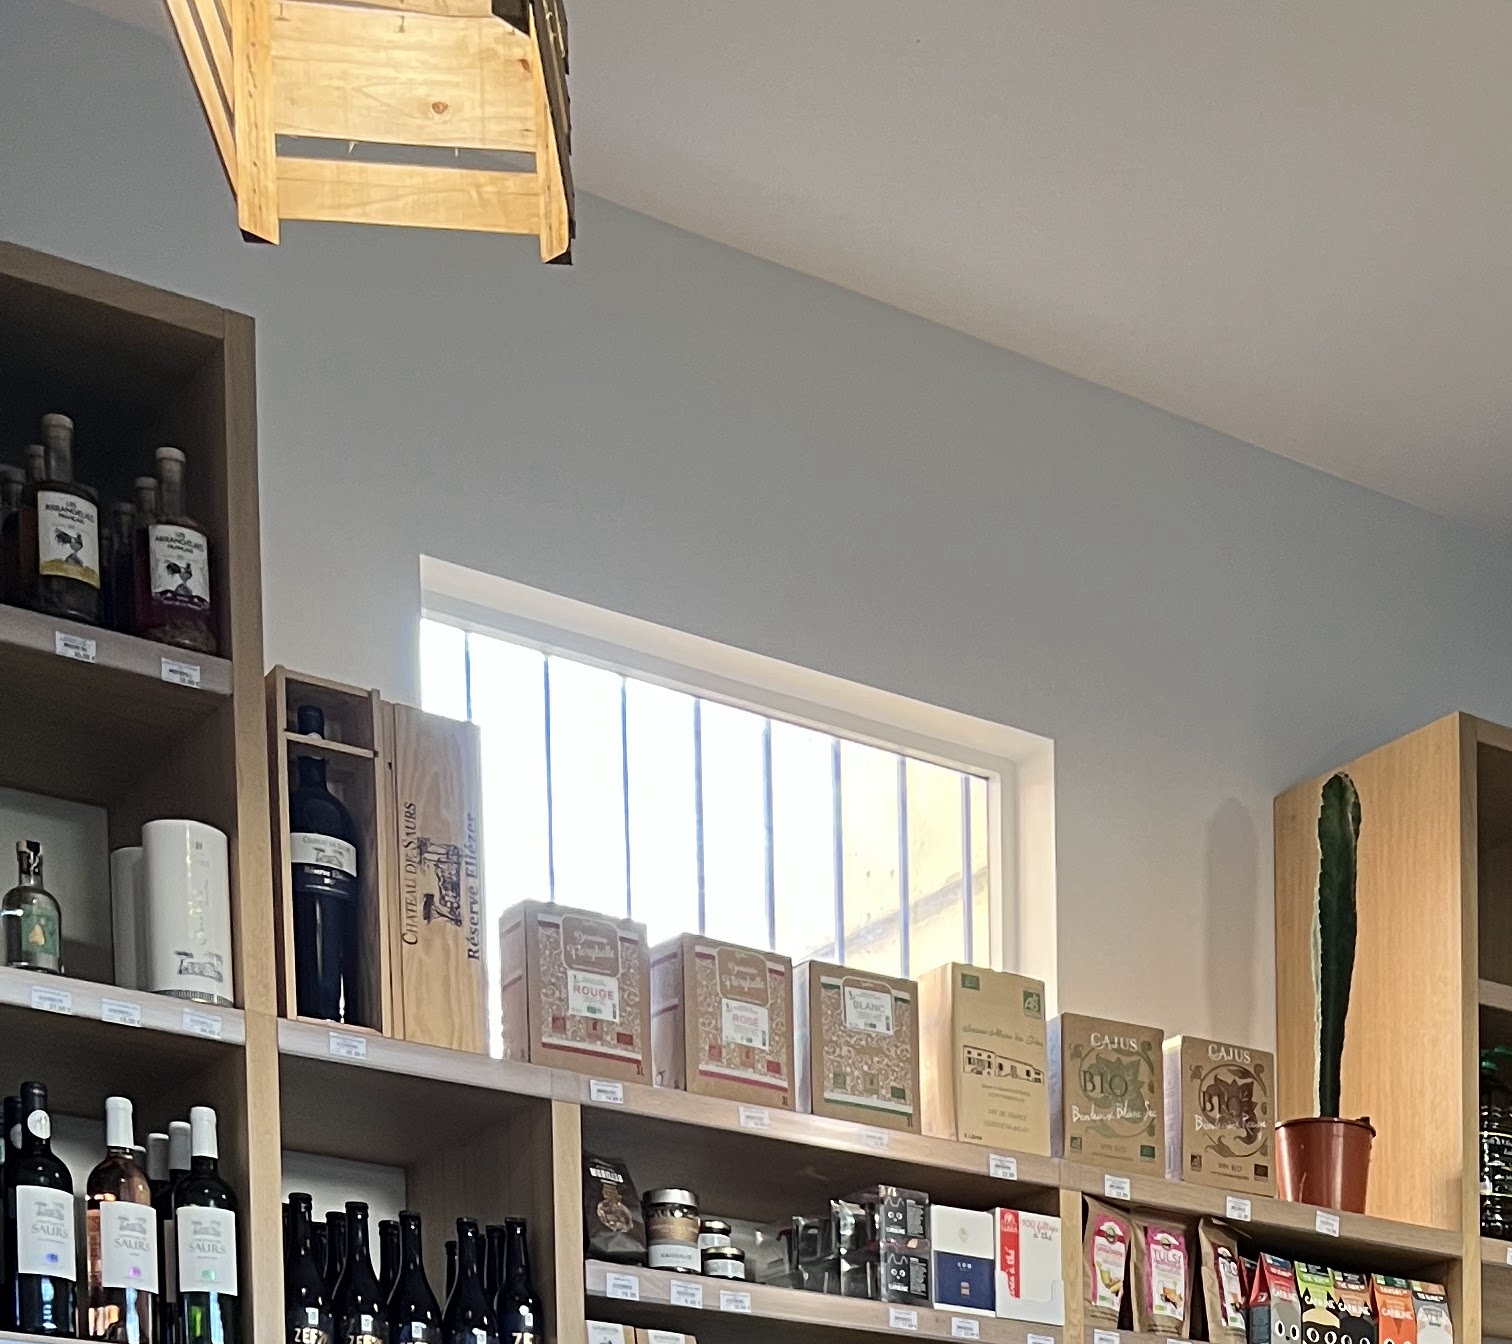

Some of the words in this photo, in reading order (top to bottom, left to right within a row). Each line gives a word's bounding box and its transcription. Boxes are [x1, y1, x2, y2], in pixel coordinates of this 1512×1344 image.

[403, 801, 418, 850] SAURS
[402, 874, 418, 945] CHATEAU
[465, 884, 480, 961] Réserve
[572, 983, 615, 1001] ROUGE
[851, 999, 887, 1014] BLANC
[732, 1013, 760, 1029] ROSÉ
[1090, 1032, 1138, 1052] CAJUS
[1207, 1043, 1251, 1064] CAJUS
[1082, 1069, 1129, 1098] BIO
[31, 1222, 69, 1241] SAURS
[113, 1236, 151, 1254] SAURS
[188, 1241, 226, 1256] SAURS
